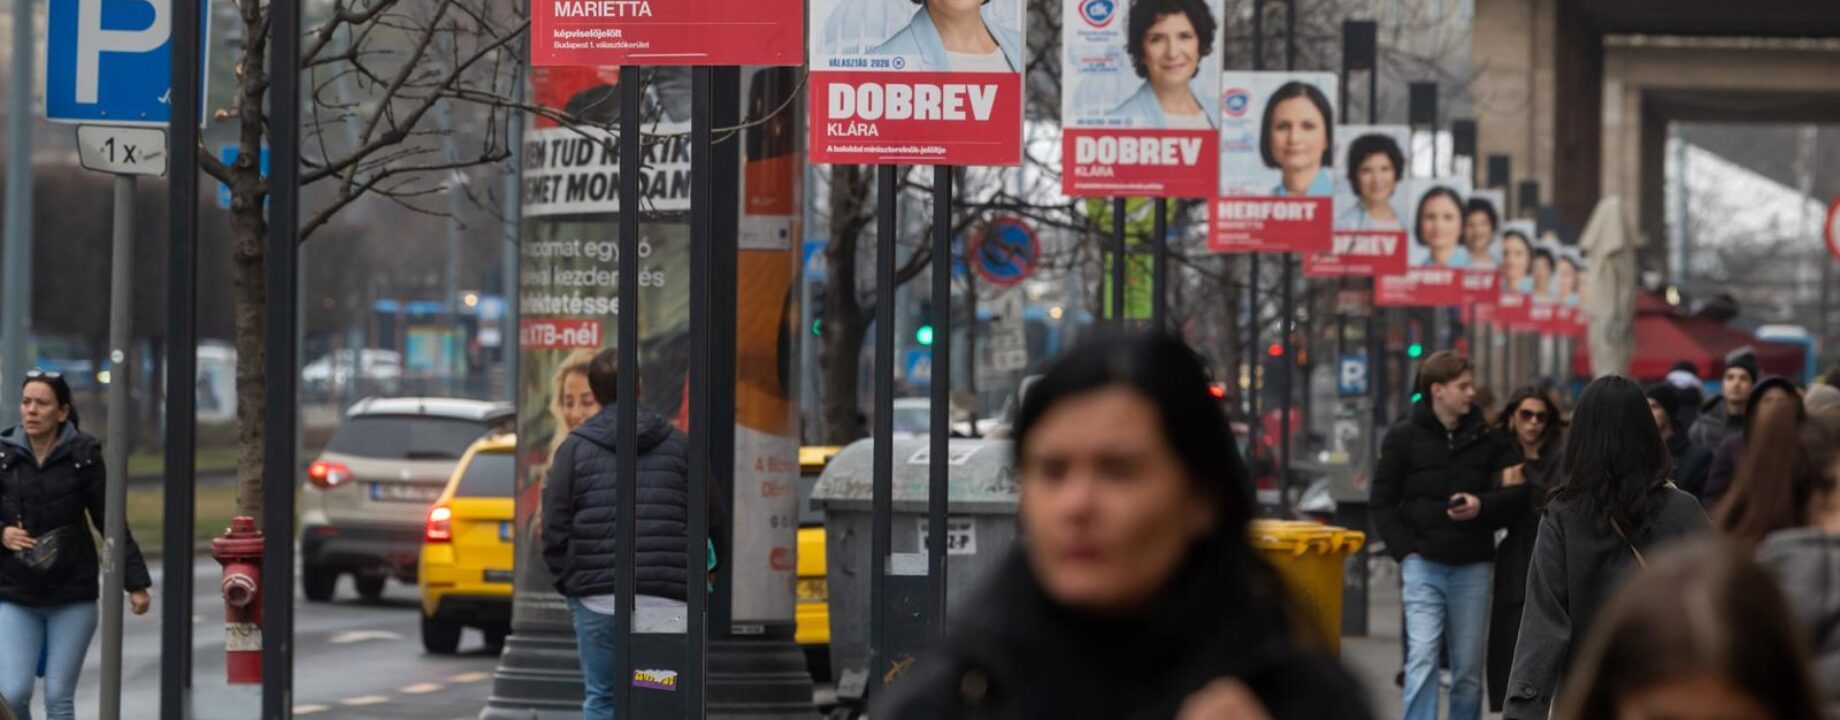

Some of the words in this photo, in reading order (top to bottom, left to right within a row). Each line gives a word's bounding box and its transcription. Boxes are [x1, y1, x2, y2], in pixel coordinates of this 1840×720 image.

[553, 0, 652, 17] MARIETTA
[553, 28, 622, 39] képviselőjelölt
[75, 0, 172, 104] P
[553, 41, 588, 49] Budapest
[828, 57, 868, 68] VÁLASZTÁS
[828, 82, 999, 121] DOBREV
[826, 121, 879, 137] KLÁRA
[551, 138, 594, 168] TUD
[1075, 136, 1203, 166] DOBREV
[523, 174, 563, 206] EMET
[1217, 202, 1318, 221] HERFORT
[637, 266, 669, 287] és
